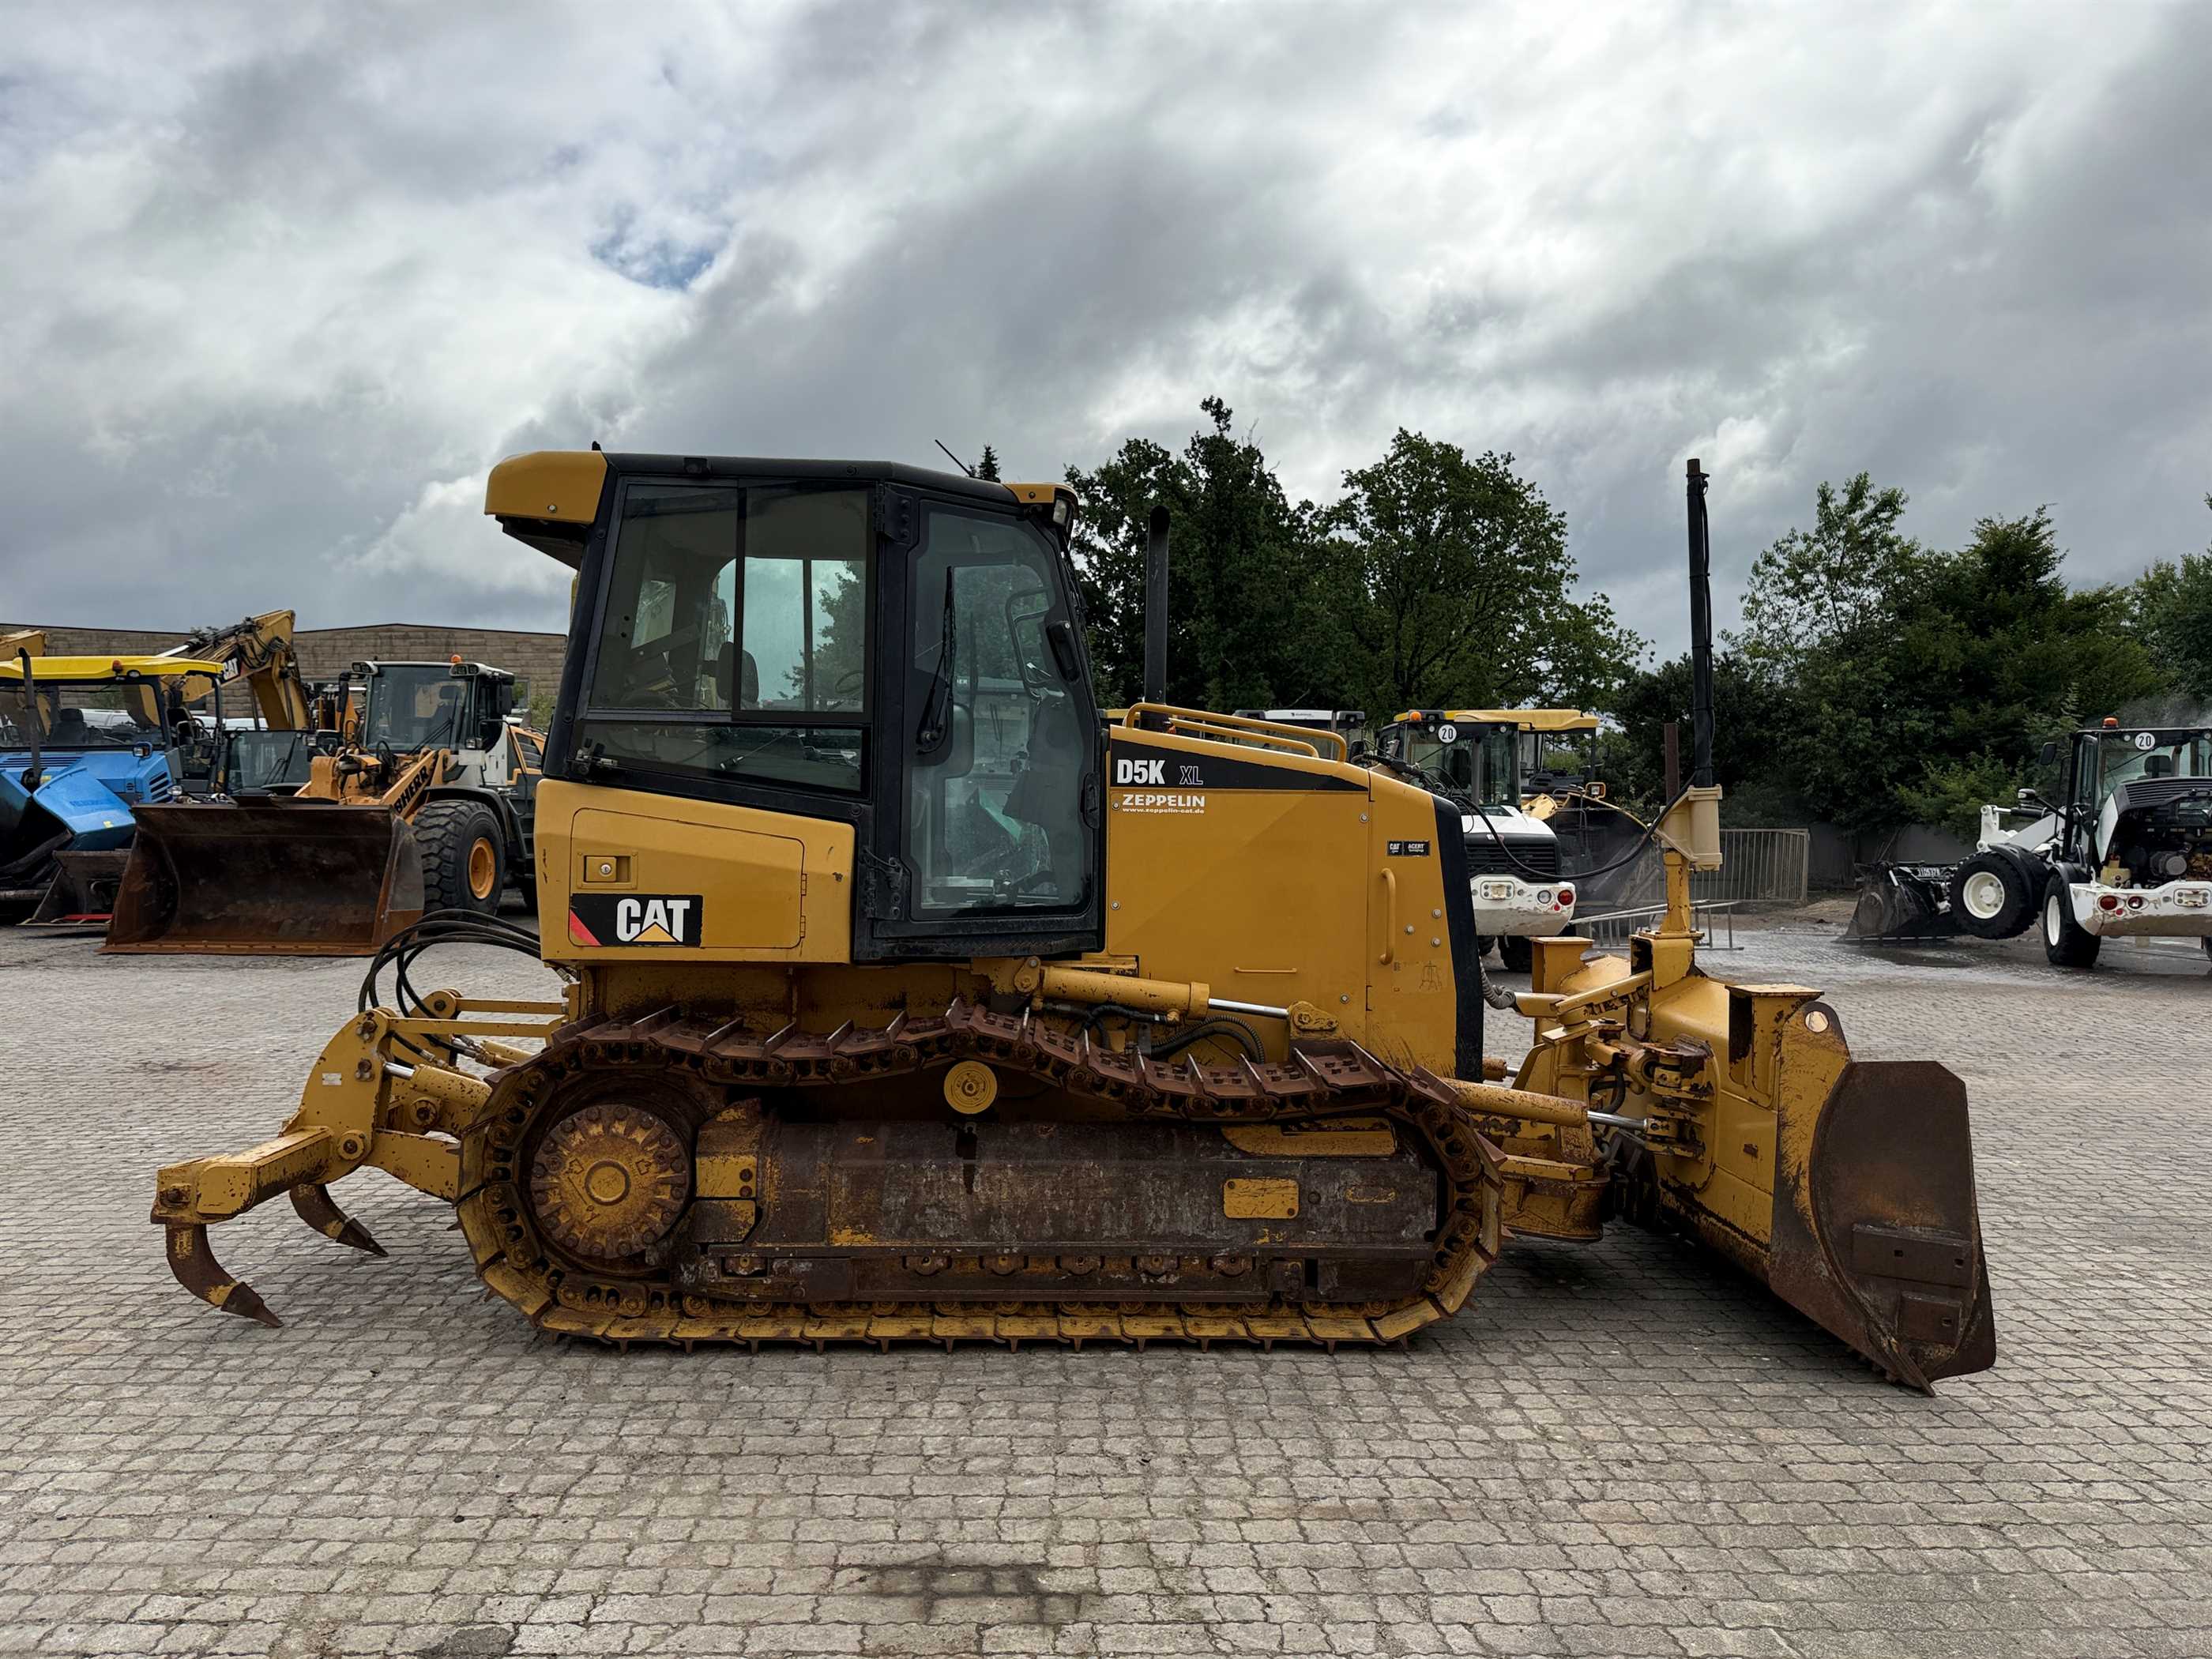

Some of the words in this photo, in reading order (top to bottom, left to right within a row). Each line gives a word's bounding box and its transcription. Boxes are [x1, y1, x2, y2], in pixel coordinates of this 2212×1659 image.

[1442, 728, 1454, 739] 20
[2139, 735, 2151, 747] 20
[1117, 759, 1165, 784] D5K
[1179, 766, 1204, 785] XL
[1123, 794, 1206, 807] ZEPPELIN
[616, 898, 690, 942] CAT
